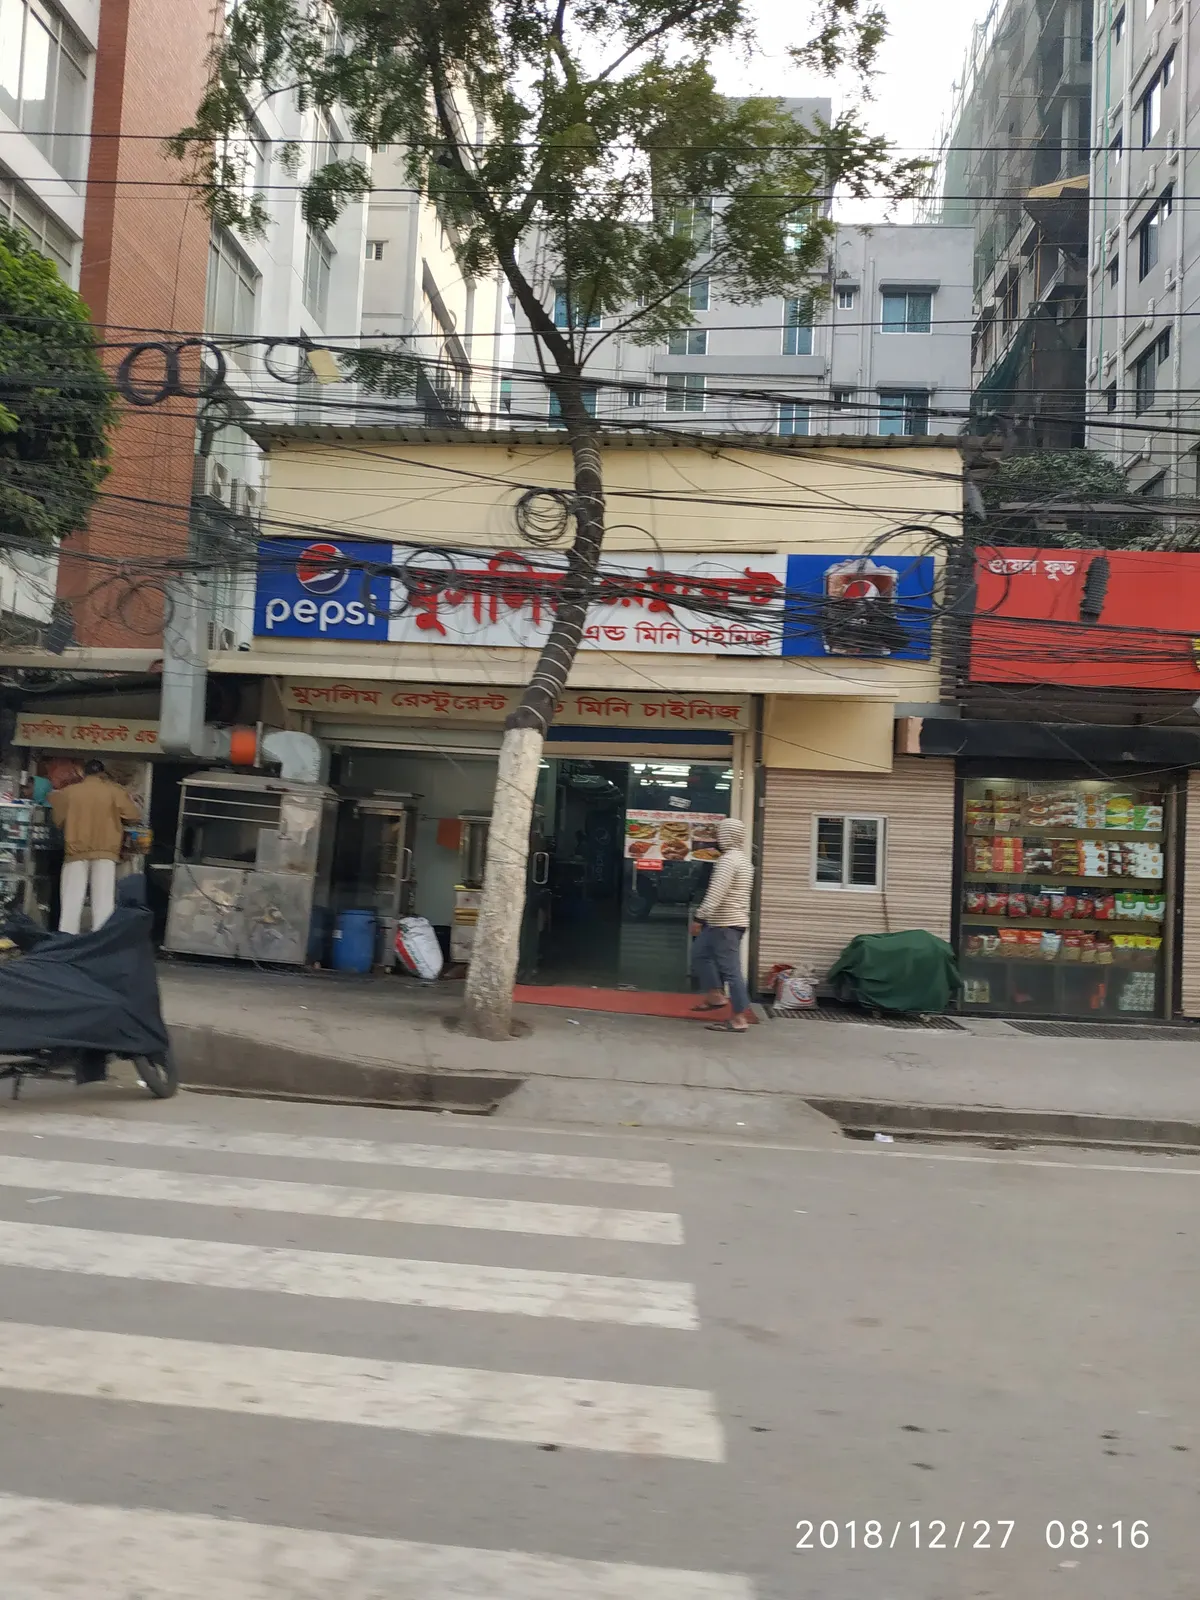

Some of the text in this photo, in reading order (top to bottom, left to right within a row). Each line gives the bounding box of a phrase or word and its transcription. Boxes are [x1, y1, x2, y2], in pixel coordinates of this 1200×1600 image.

[1043, 560, 1078, 581] ফুড
[265, 593, 377, 631] pepsi
[584, 621, 772, 648] এন্ড মিনি চাইনিজ
[291, 684, 383, 706] মুসলিম
[392, 690, 509, 714] রেস্টুরেন্ট
[576, 696, 633, 718] মিনি
[640, 698, 744, 720] চাইনিজ
